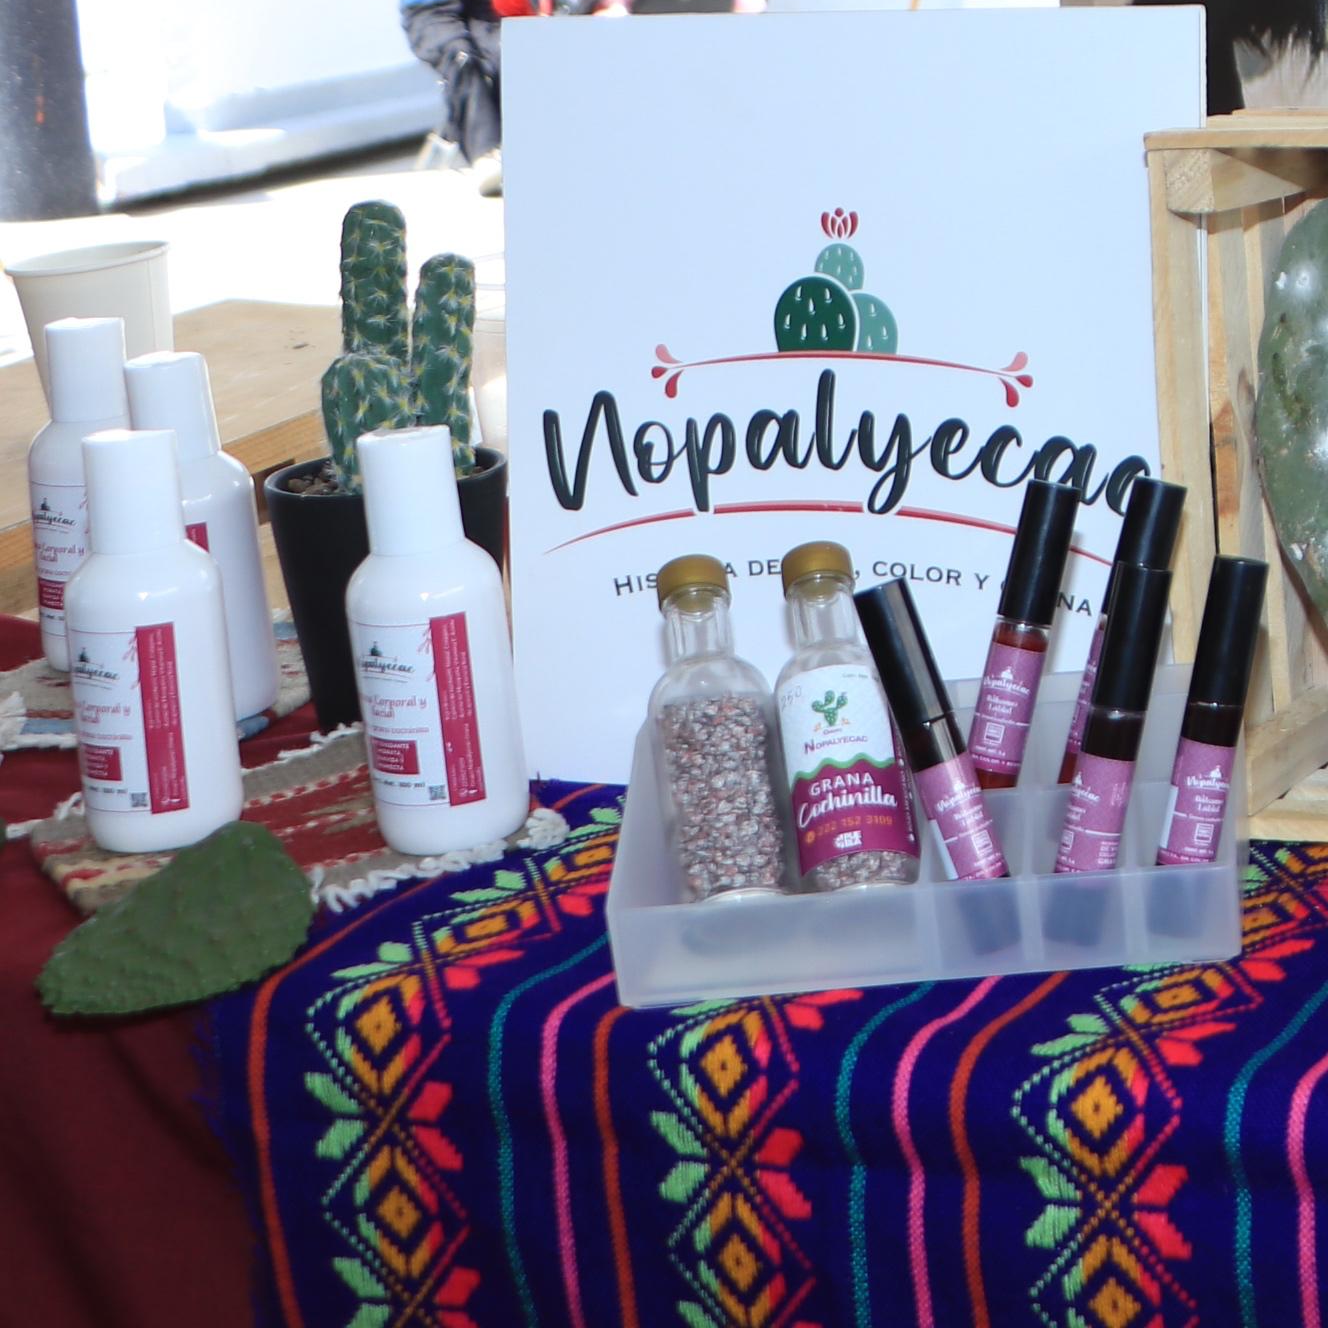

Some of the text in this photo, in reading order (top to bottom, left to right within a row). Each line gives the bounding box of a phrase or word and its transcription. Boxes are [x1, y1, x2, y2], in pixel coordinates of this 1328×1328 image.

[872, 560, 961, 586] COLOR
[974, 574, 990, 591] Y
[810, 772, 875, 796] GRANA
[798, 785, 898, 828] Cochinilla
